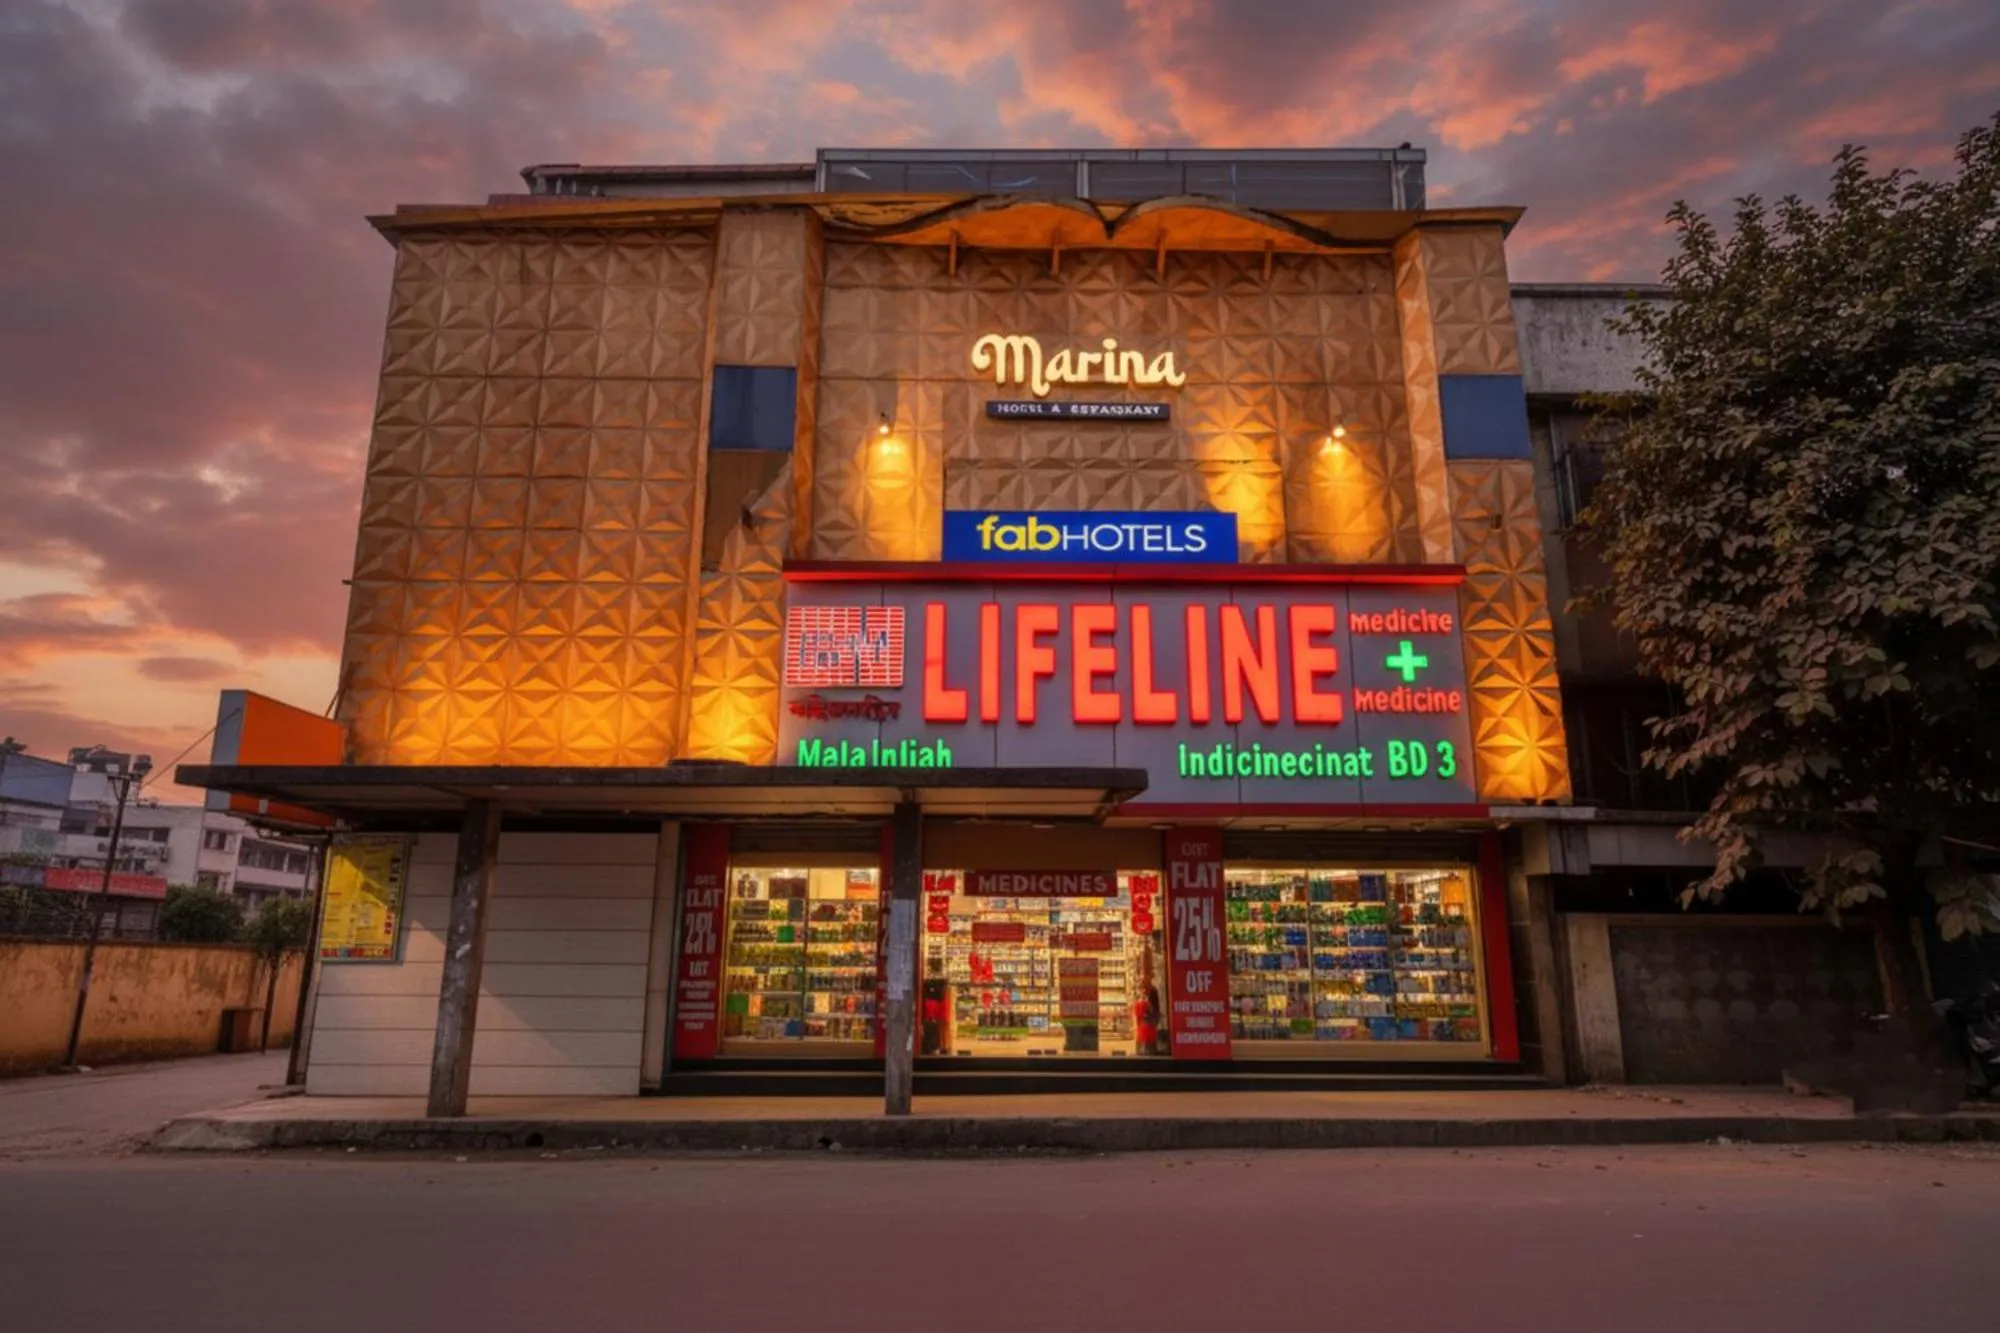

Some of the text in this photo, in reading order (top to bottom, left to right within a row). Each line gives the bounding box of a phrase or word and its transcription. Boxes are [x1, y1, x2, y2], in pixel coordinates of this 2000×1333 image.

[971, 333, 1186, 396] Marina
[922, 602, 1344, 724] LIFELINE
[1387, 740, 1428, 778] BD
[1436, 740, 1456, 778] 3
[977, 874, 1109, 893] MEDICINES
[1171, 861, 1221, 890] FLAT
[1173, 895, 1221, 962] 25%
[1185, 970, 1213, 994] OFF
